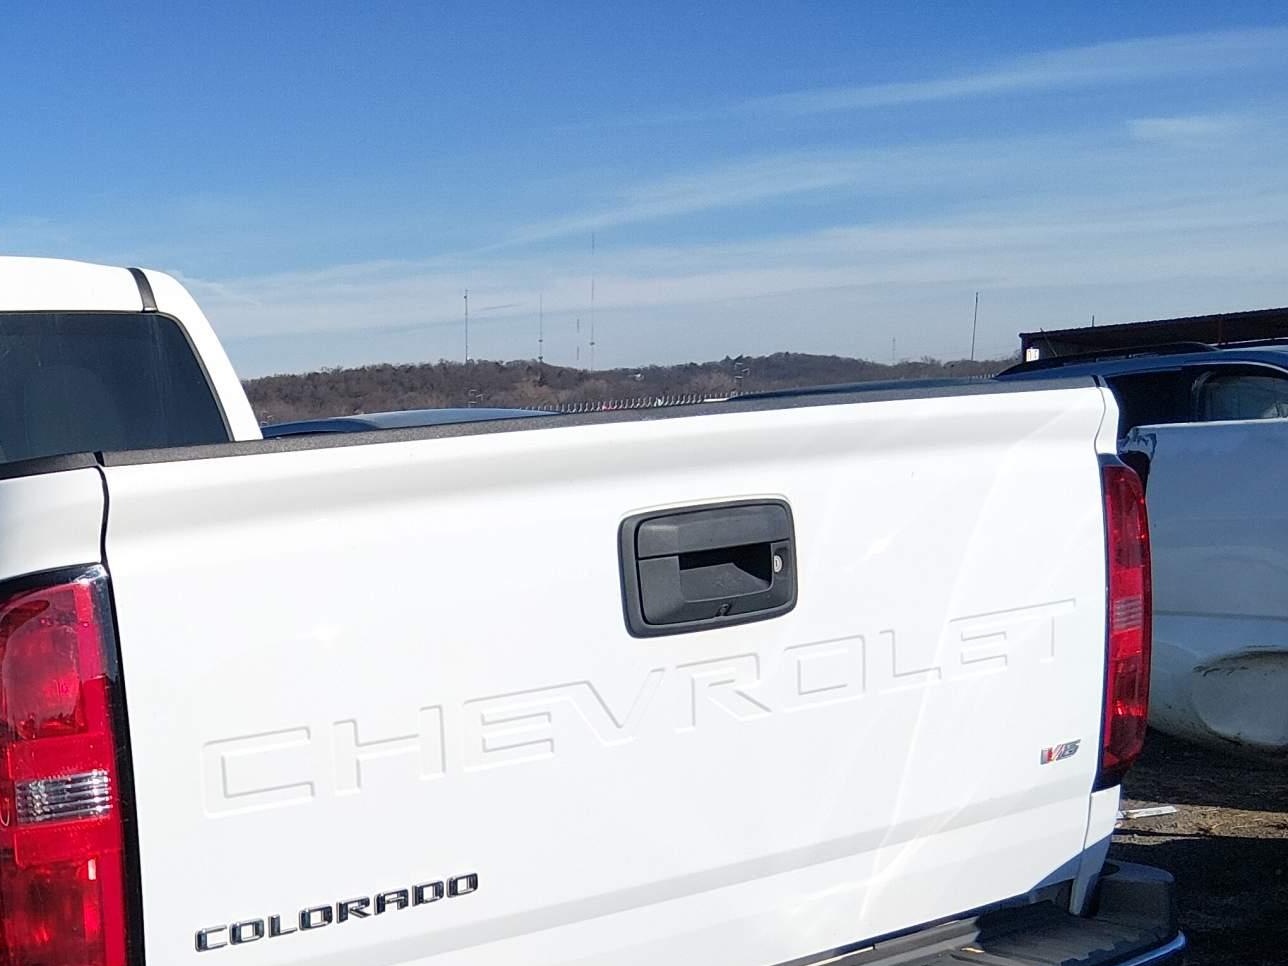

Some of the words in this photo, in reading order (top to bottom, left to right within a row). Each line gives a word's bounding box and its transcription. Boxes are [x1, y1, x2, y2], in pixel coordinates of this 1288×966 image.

[202, 598, 1077, 819] CHEVROLET
[1040, 739, 1081, 765] V6
[195, 872, 479, 953] COLORADO
